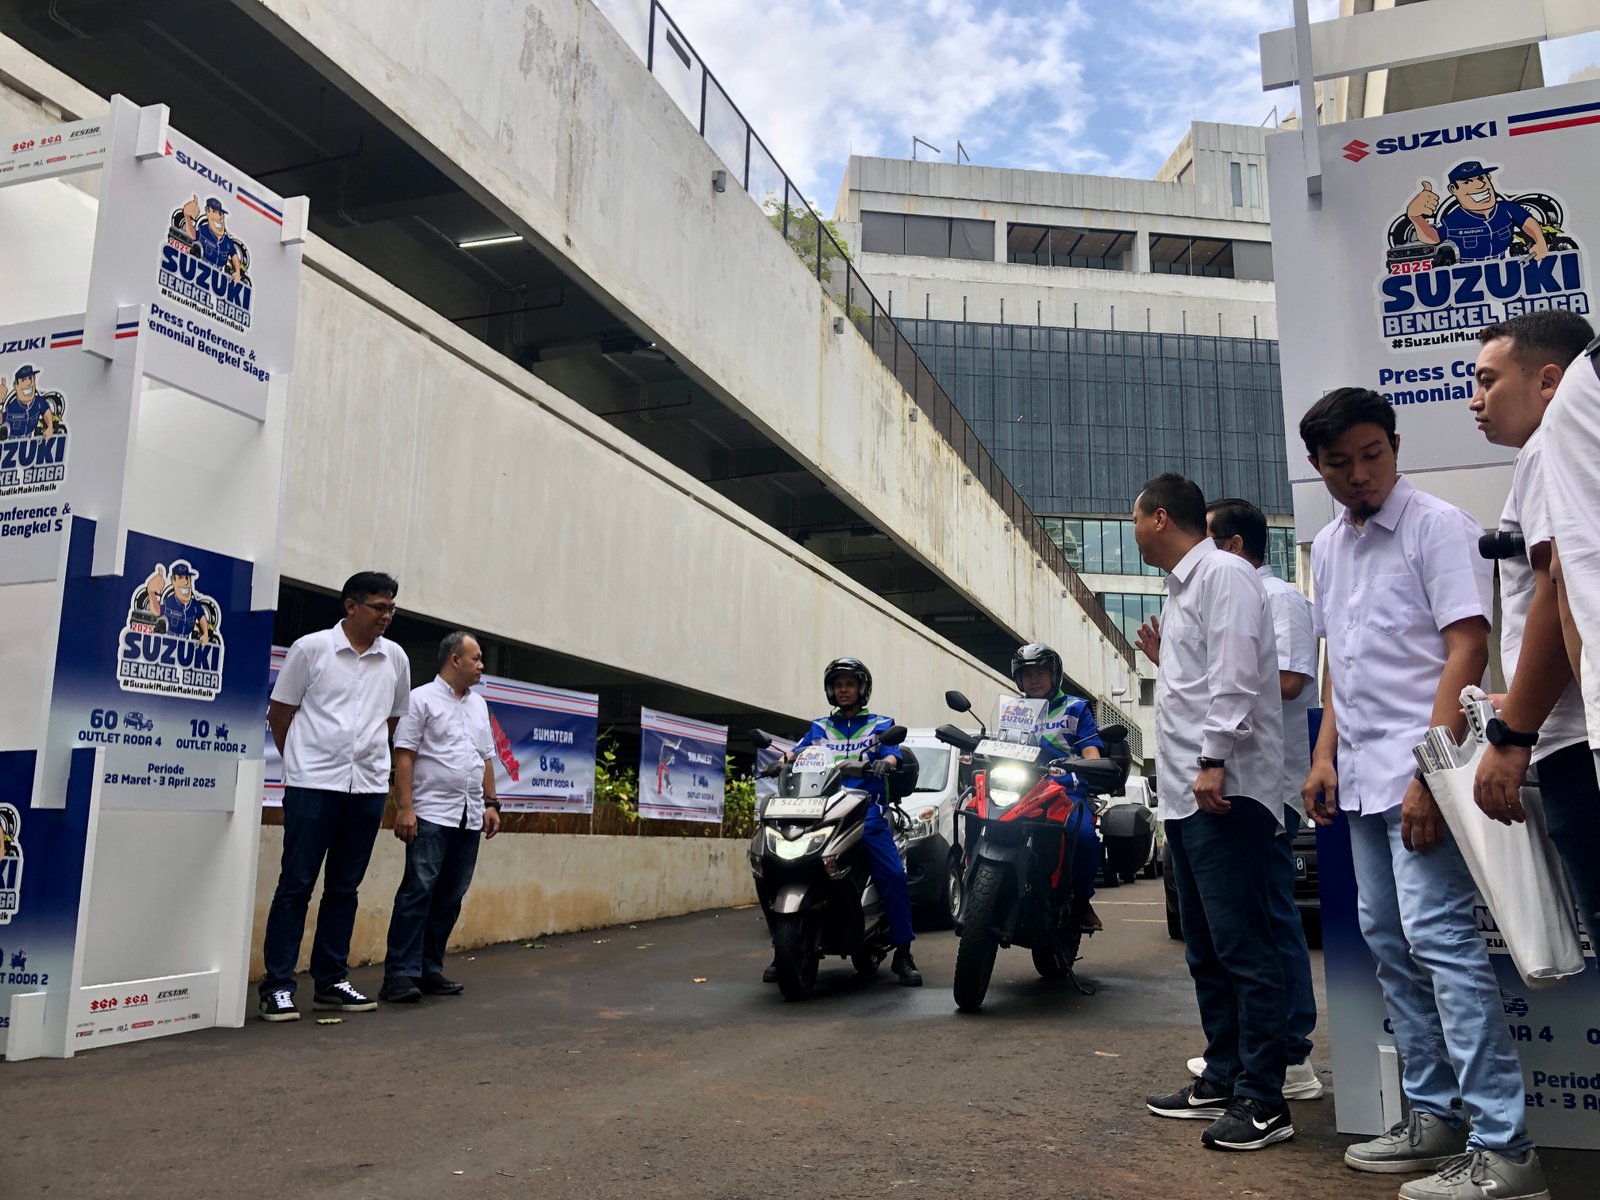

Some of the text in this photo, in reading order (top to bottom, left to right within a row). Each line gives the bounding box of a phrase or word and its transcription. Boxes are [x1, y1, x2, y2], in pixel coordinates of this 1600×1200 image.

[1376, 121, 1497, 154] SUZUKI
[176, 150, 232, 193] SUZUKI
[1391, 260, 1432, 275] 2025
[162, 245, 252, 310] SUZUKI
[1382, 253, 1581, 313] SUZUKI
[159, 269, 250, 328] BENGKEL SIAGA
[1383, 304, 1498, 337] BENGKEL
[151, 303, 256, 361] Press Conference &
[148, 318, 270, 382] emonial Bengkel Siaga
[1379, 366, 1444, 386] Press
[0, 436, 66, 469] ZUKI
[23, 464, 64, 484] SIAGA
[62, 502, 71, 515] &
[2, 520, 62, 538] Bengkel S
[132, 621, 155, 634] 2025
[123, 632, 220, 672] SUZUKI
[120, 660, 220, 690] BENGKEL SIAGA
[90, 708, 118, 730] 60
[1000, 715, 1034, 725] SUZUKI
[190, 718, 210, 738] 10
[533, 728, 574, 744] SUMATERA
[78, 731, 162, 747] OUTLET RODA 4
[176, 738, 247, 754] OUTLET RODA 2
[826, 739, 872, 752] SUZUKI
[148, 763, 184, 775] Periode
[540, 756, 548, 772] 8
[104, 774, 118, 784] 28
[121, 774, 150, 786] Maret
[160, 776, 165, 786] 3
[168, 776, 190, 788] April
[192, 778, 216, 788] 2025
[532, 778, 553, 788] OUTLET
[570, 780, 574, 788] 4
[8, 973, 38, 985] RODA
[41, 974, 48, 986] 2
[158, 988, 189, 999] ECSTAR
[1538, 1026, 1554, 1042] 4
[1562, 1093, 1576, 1110] 3
